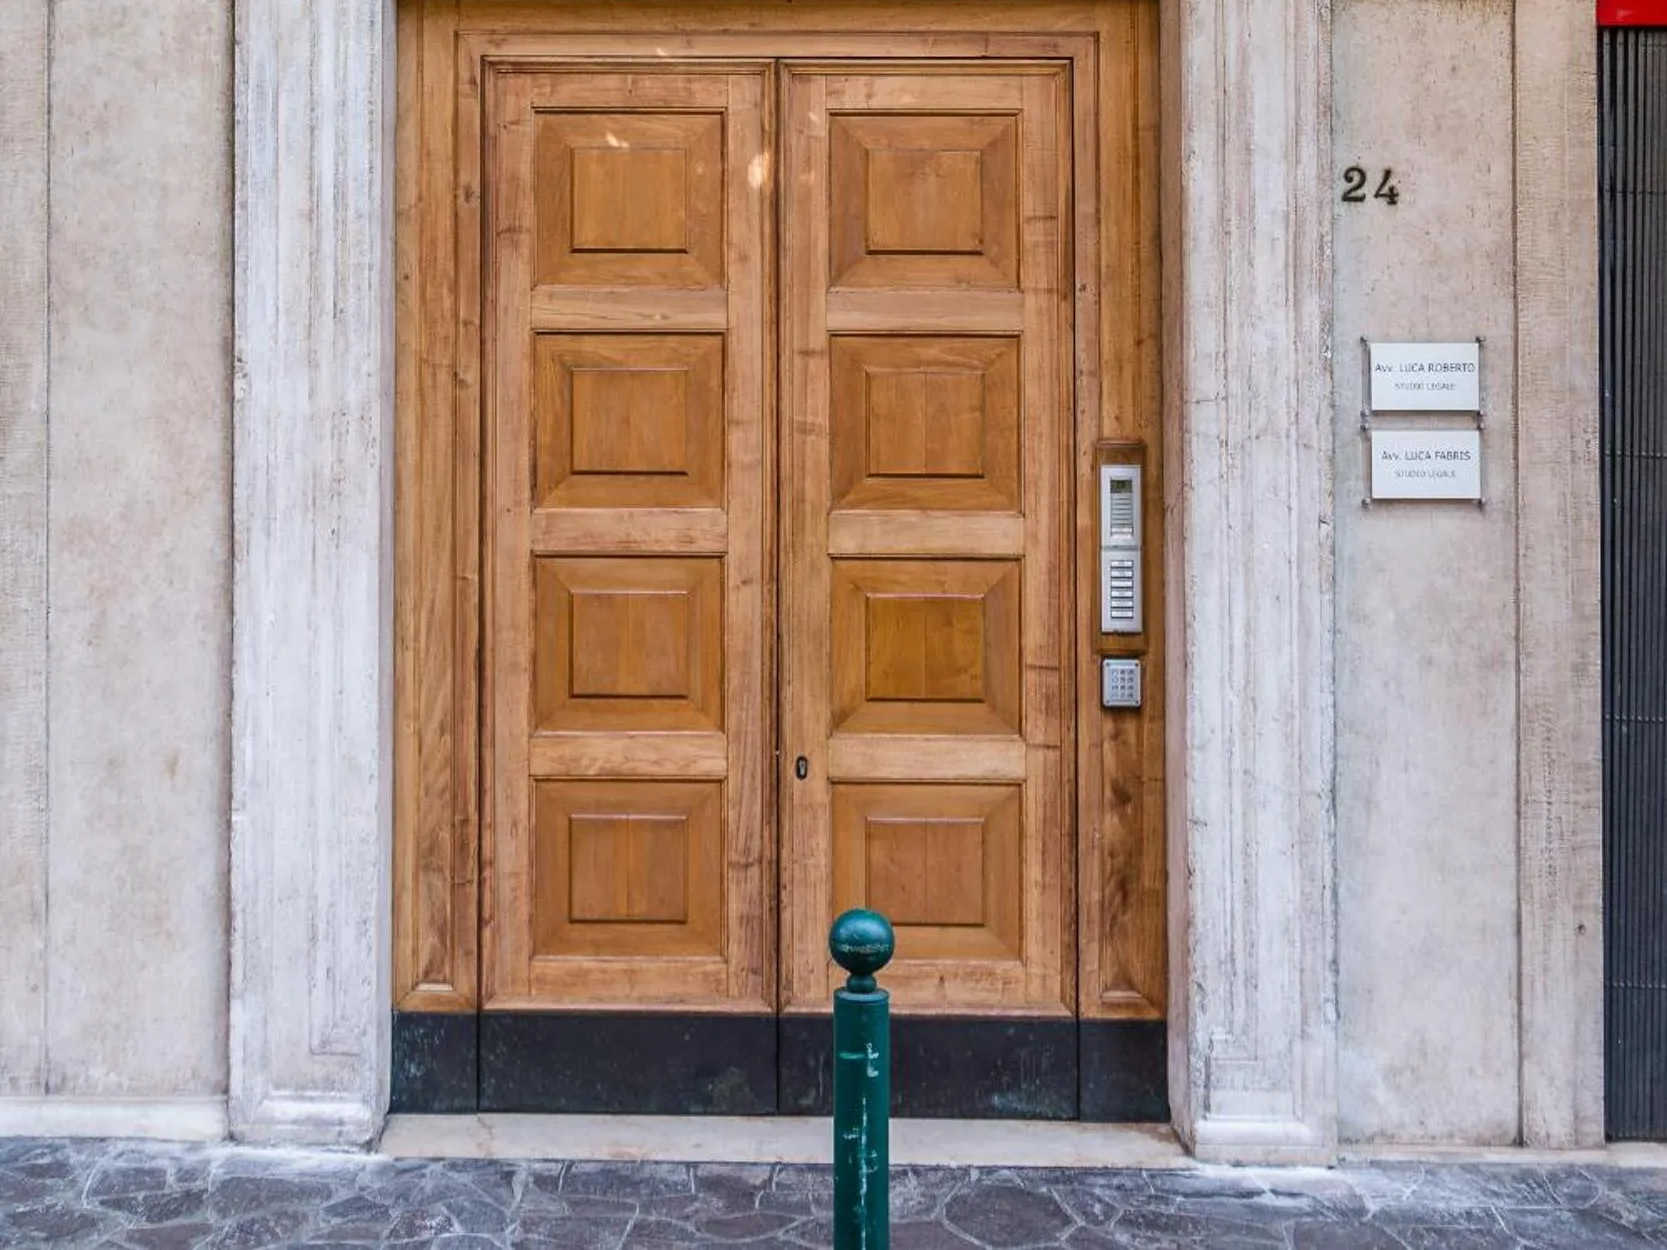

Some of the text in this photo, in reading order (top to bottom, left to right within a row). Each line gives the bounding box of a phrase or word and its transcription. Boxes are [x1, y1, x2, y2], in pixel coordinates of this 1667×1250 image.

[1341, 166, 1400, 205] 24
[1399, 363, 1425, 373] LUCA
[1428, 363, 1476, 373] ROBERTO
[1405, 451, 1431, 461] LUCA
[1434, 451, 1471, 461] FABRIS
